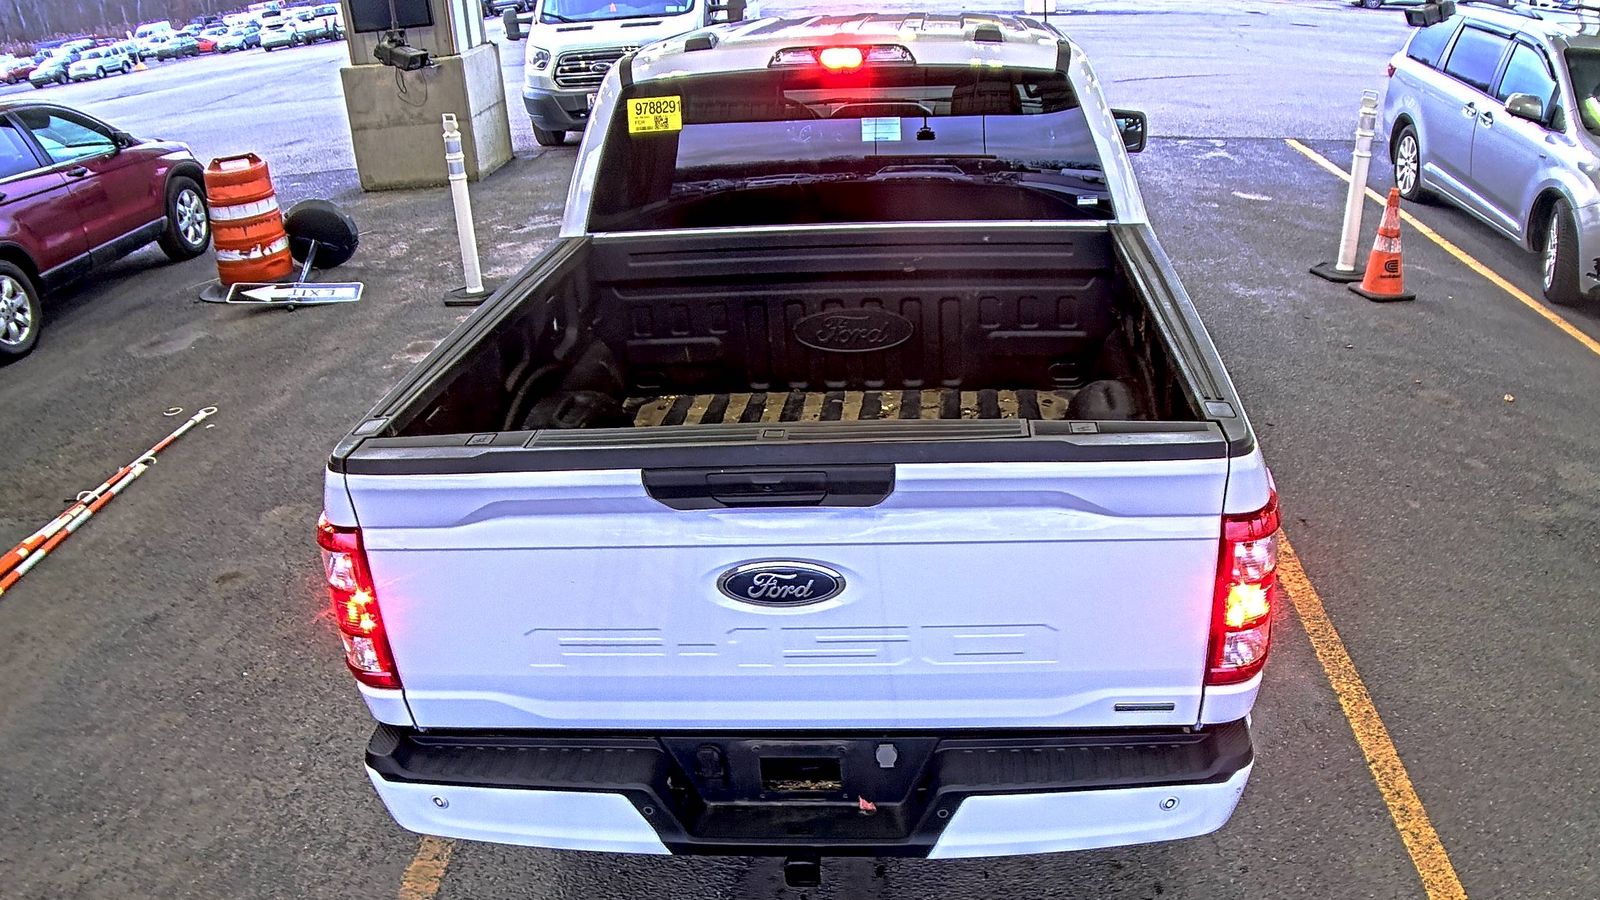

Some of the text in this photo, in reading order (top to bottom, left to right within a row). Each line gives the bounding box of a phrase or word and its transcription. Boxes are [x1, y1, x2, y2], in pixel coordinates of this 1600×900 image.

[635, 101, 681, 115] 9788291
[288, 288, 336, 297] EXIT
[816, 315, 888, 342] Ford
[747, 572, 814, 598] Ford
[524, 624, 1058, 669] F-150
